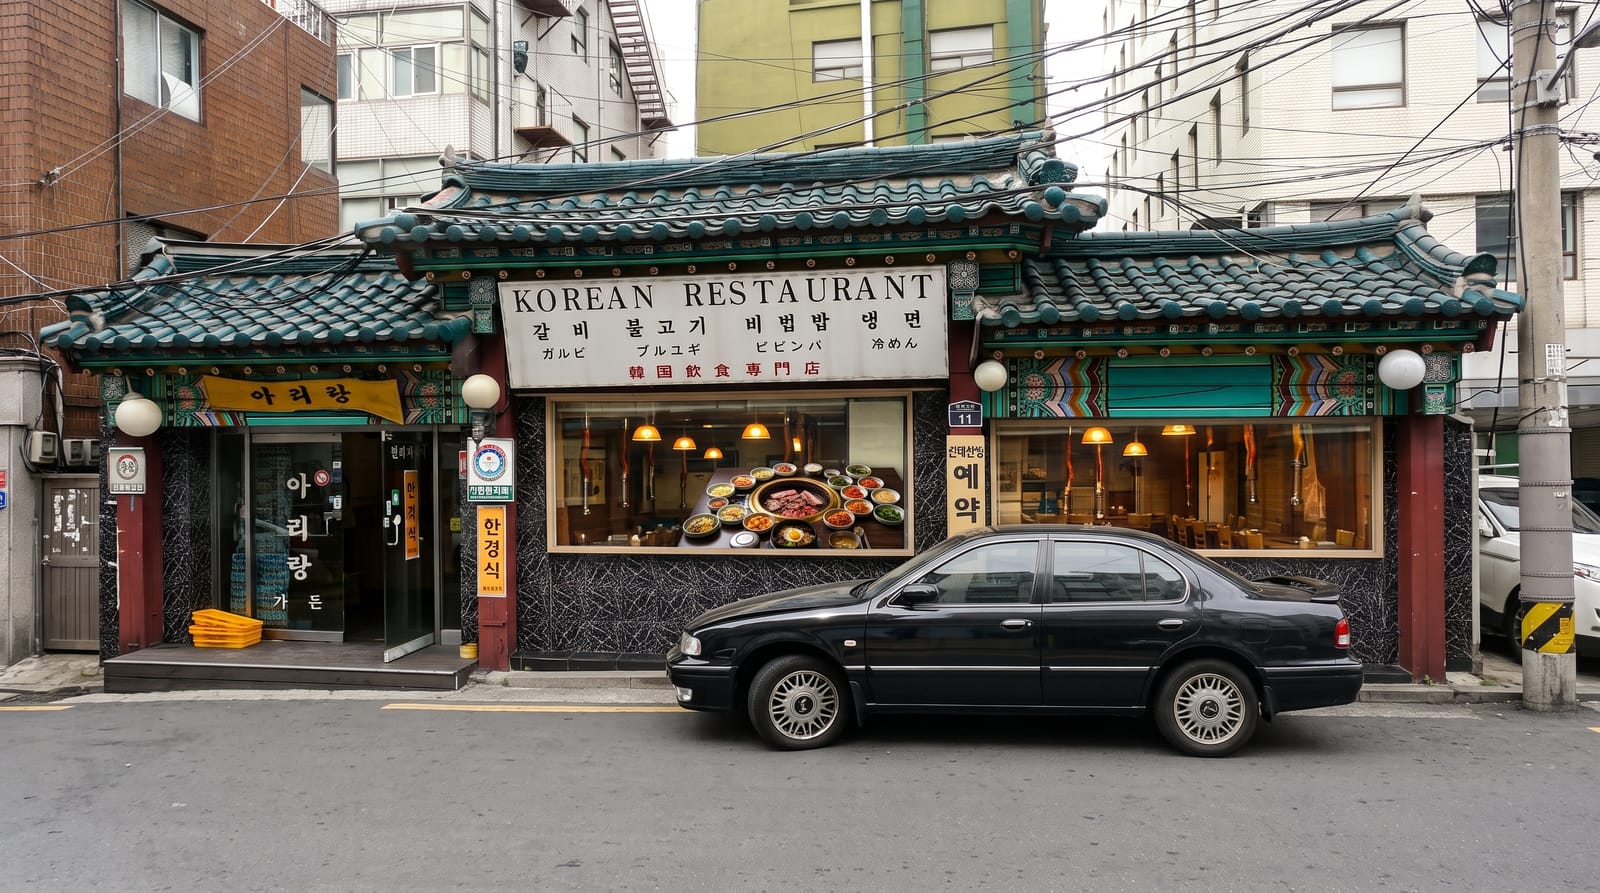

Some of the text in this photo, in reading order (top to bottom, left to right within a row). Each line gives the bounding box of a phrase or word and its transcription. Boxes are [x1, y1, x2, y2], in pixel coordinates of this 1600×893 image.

[512, 274, 933, 313] KOREAN RESTAURANT
[532, 320, 589, 341] 갈비
[625, 316, 706, 338] 불고기
[861, 310, 921, 330] 냉면
[542, 347, 586, 360] ガルビ
[872, 337, 917, 350] 冷めん
[629, 361, 820, 380] 韓国飲食専門店
[251, 384, 351, 405] 아리랑
[958, 414, 971, 425] 11
[953, 463, 980, 523] 예약
[286, 472, 312, 581] 아리랑
[483, 518, 501, 580] 한경식
[273, 594, 323, 610] 가든
